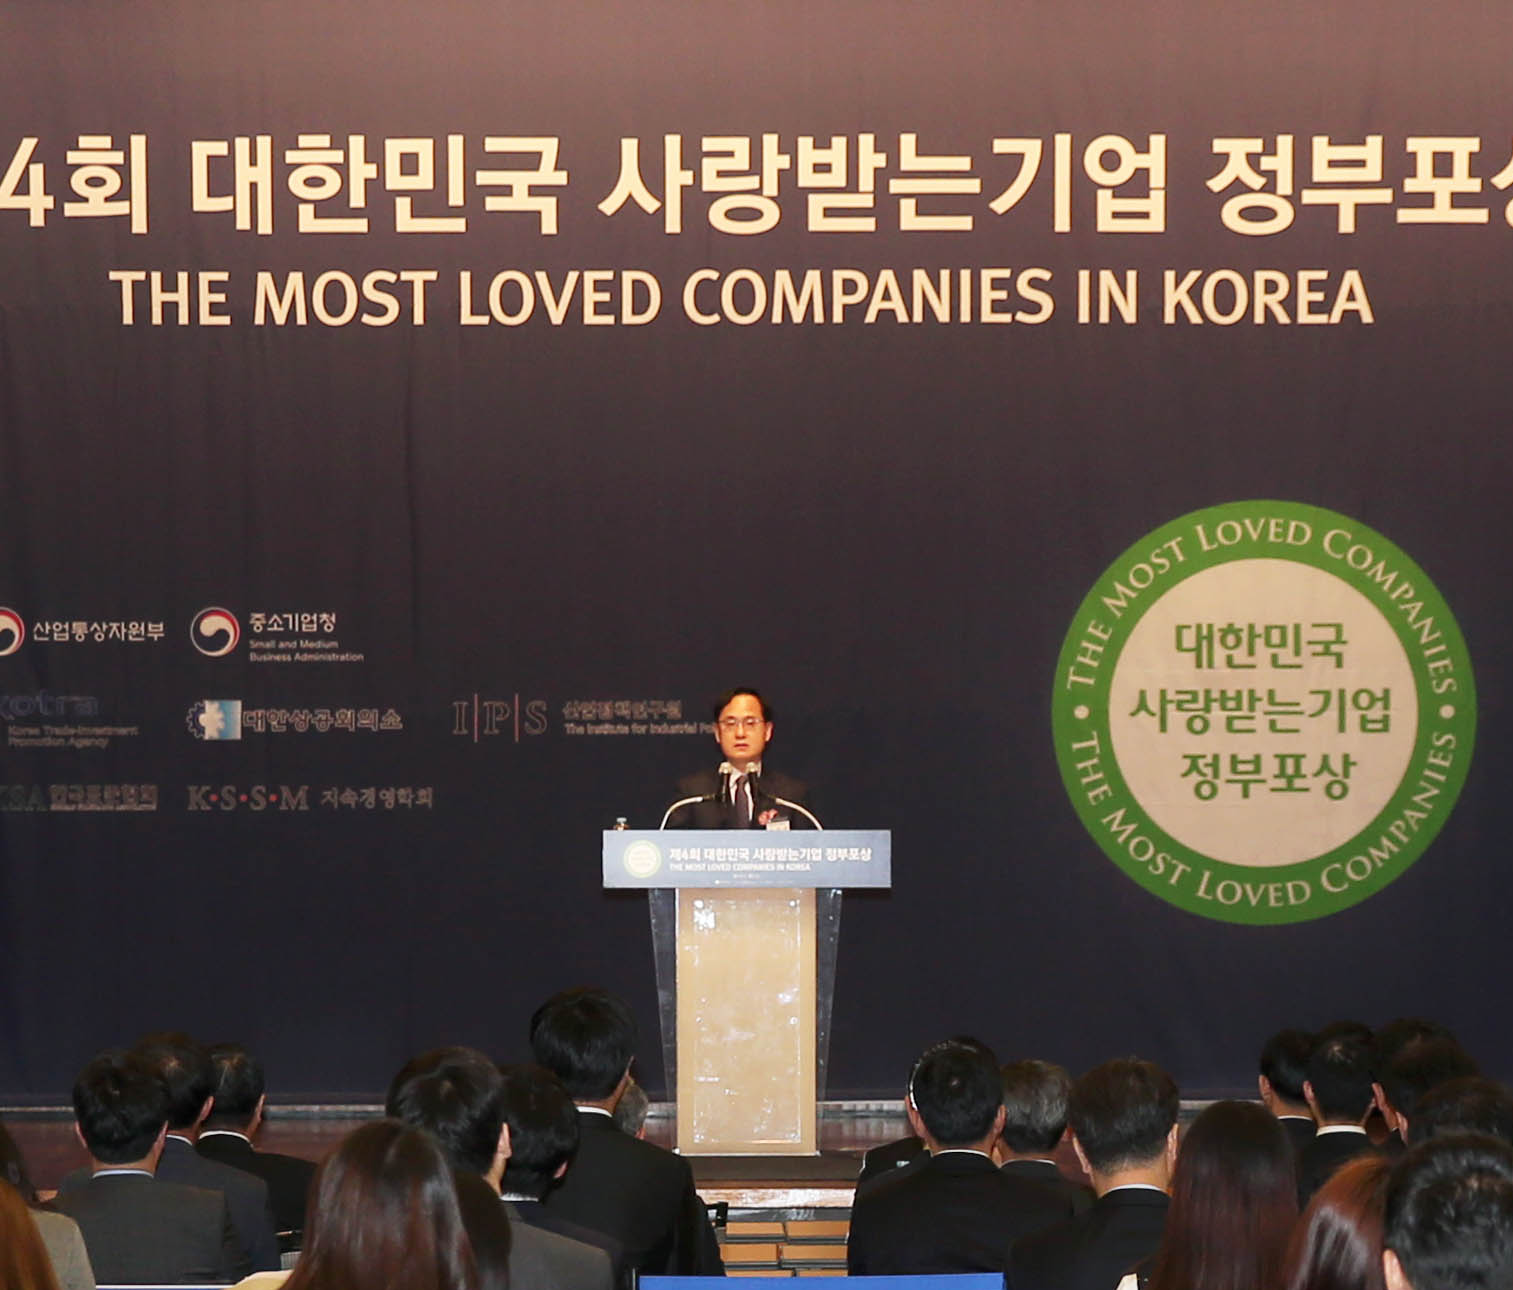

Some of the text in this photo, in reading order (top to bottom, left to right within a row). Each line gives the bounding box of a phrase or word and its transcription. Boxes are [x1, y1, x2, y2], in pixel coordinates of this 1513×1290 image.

[191, 133, 569, 235] 대한민국
[597, 133, 1166, 236] 사랑받는기업
[108, 268, 1375, 327] THE MOST LOVED COMPANIES IN KOREA
[249, 612, 337, 633] 중소기업청
[1066, 516, 1458, 696] THE MOST LOVED COMPANIES
[32, 621, 166, 643] 산업통상자원부
[249, 639, 339, 649] Small and Medium
[1175, 622, 1348, 669] 대한민국
[249, 651, 365, 662] Business Administration
[1129, 687, 1392, 736] 사랑받는기업
[1180, 753, 1357, 800] 정부포상
[1071, 730, 1457, 909] THE MOST LOVED COMPANIES
